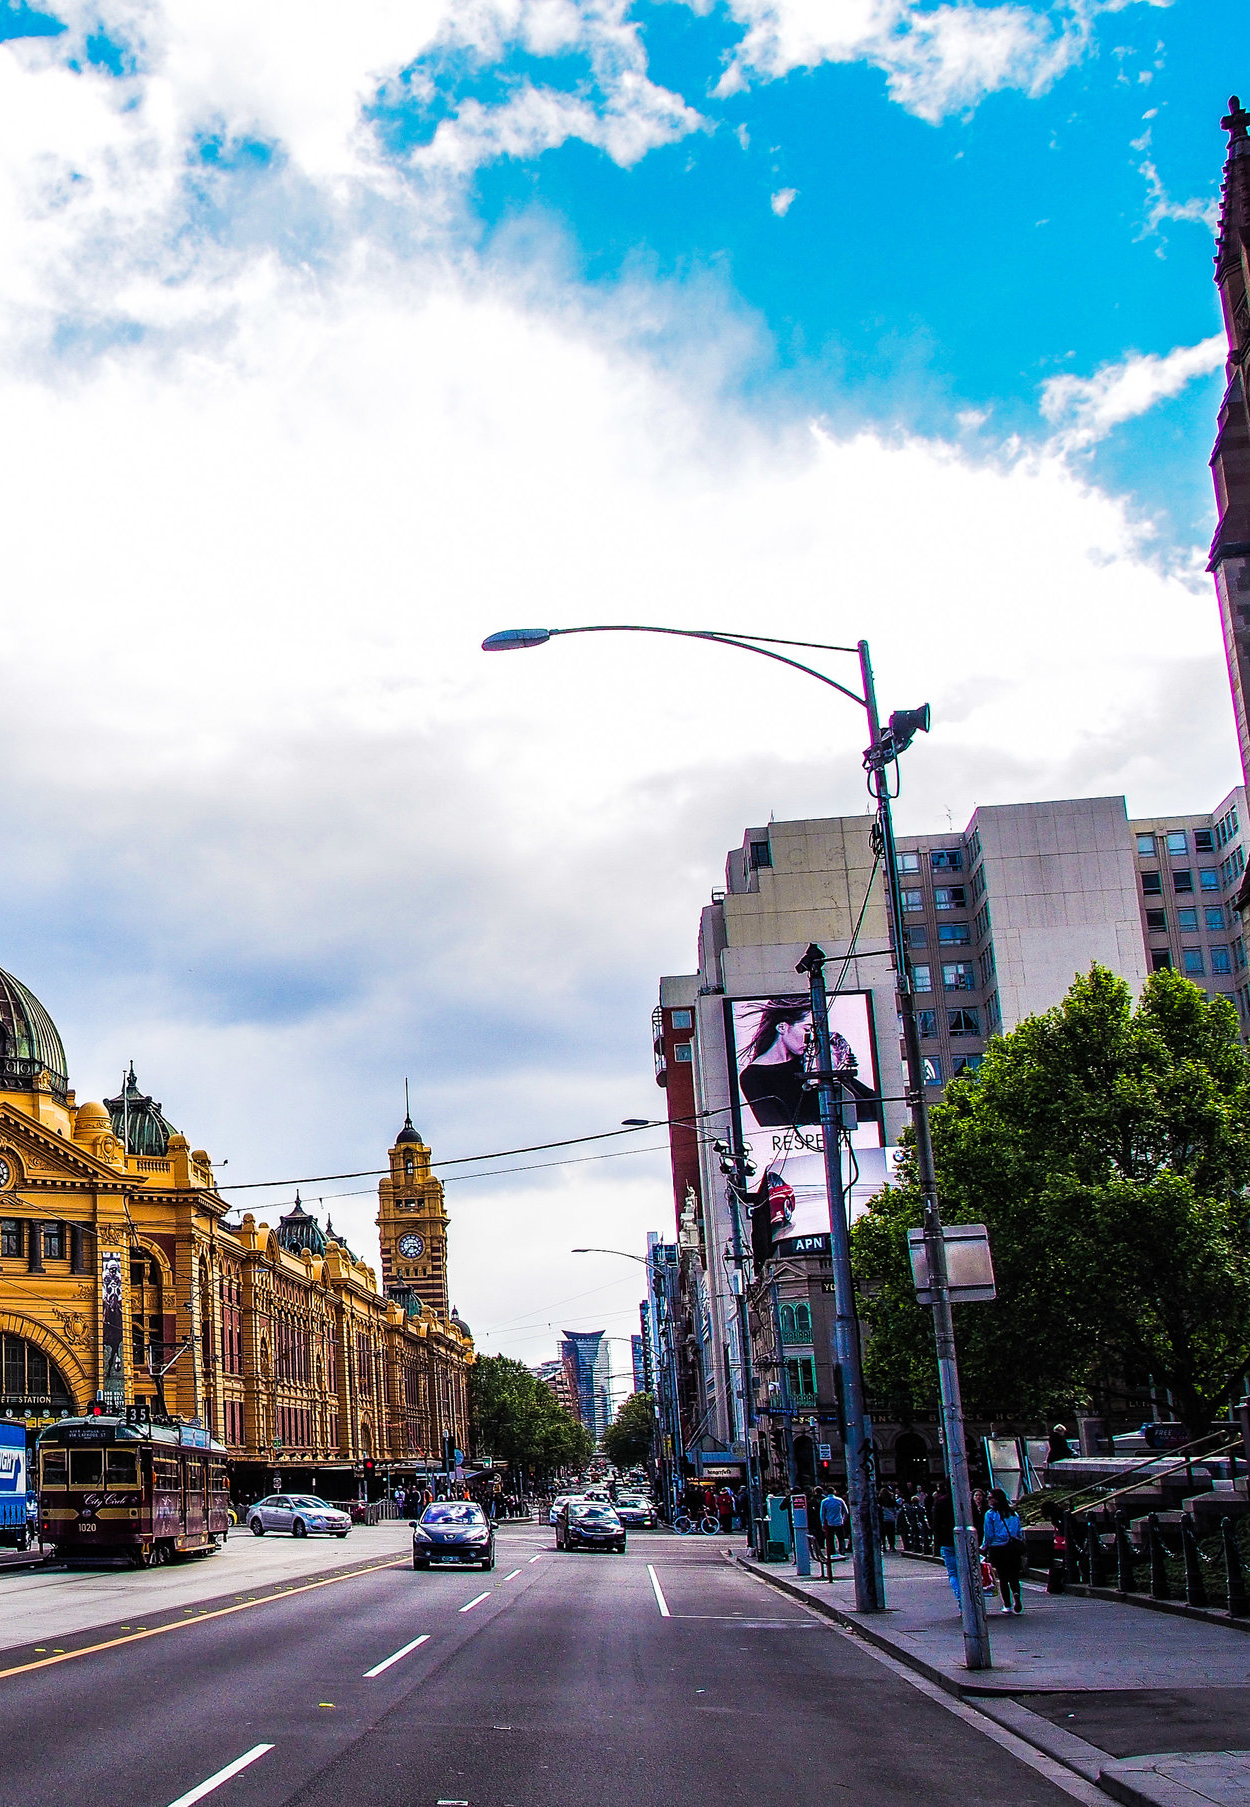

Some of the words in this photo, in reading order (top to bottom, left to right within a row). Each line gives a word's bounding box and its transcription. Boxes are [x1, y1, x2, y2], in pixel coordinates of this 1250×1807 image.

[796, 1237, 823, 1251] APN
[18, 1396, 51, 1404] STATION
[130, 1408, 147, 1421] 35
[83, 1493, 104, 1508] City
[103, 1493, 129, 1505] Circle
[78, 1523, 97, 1532] 1020
